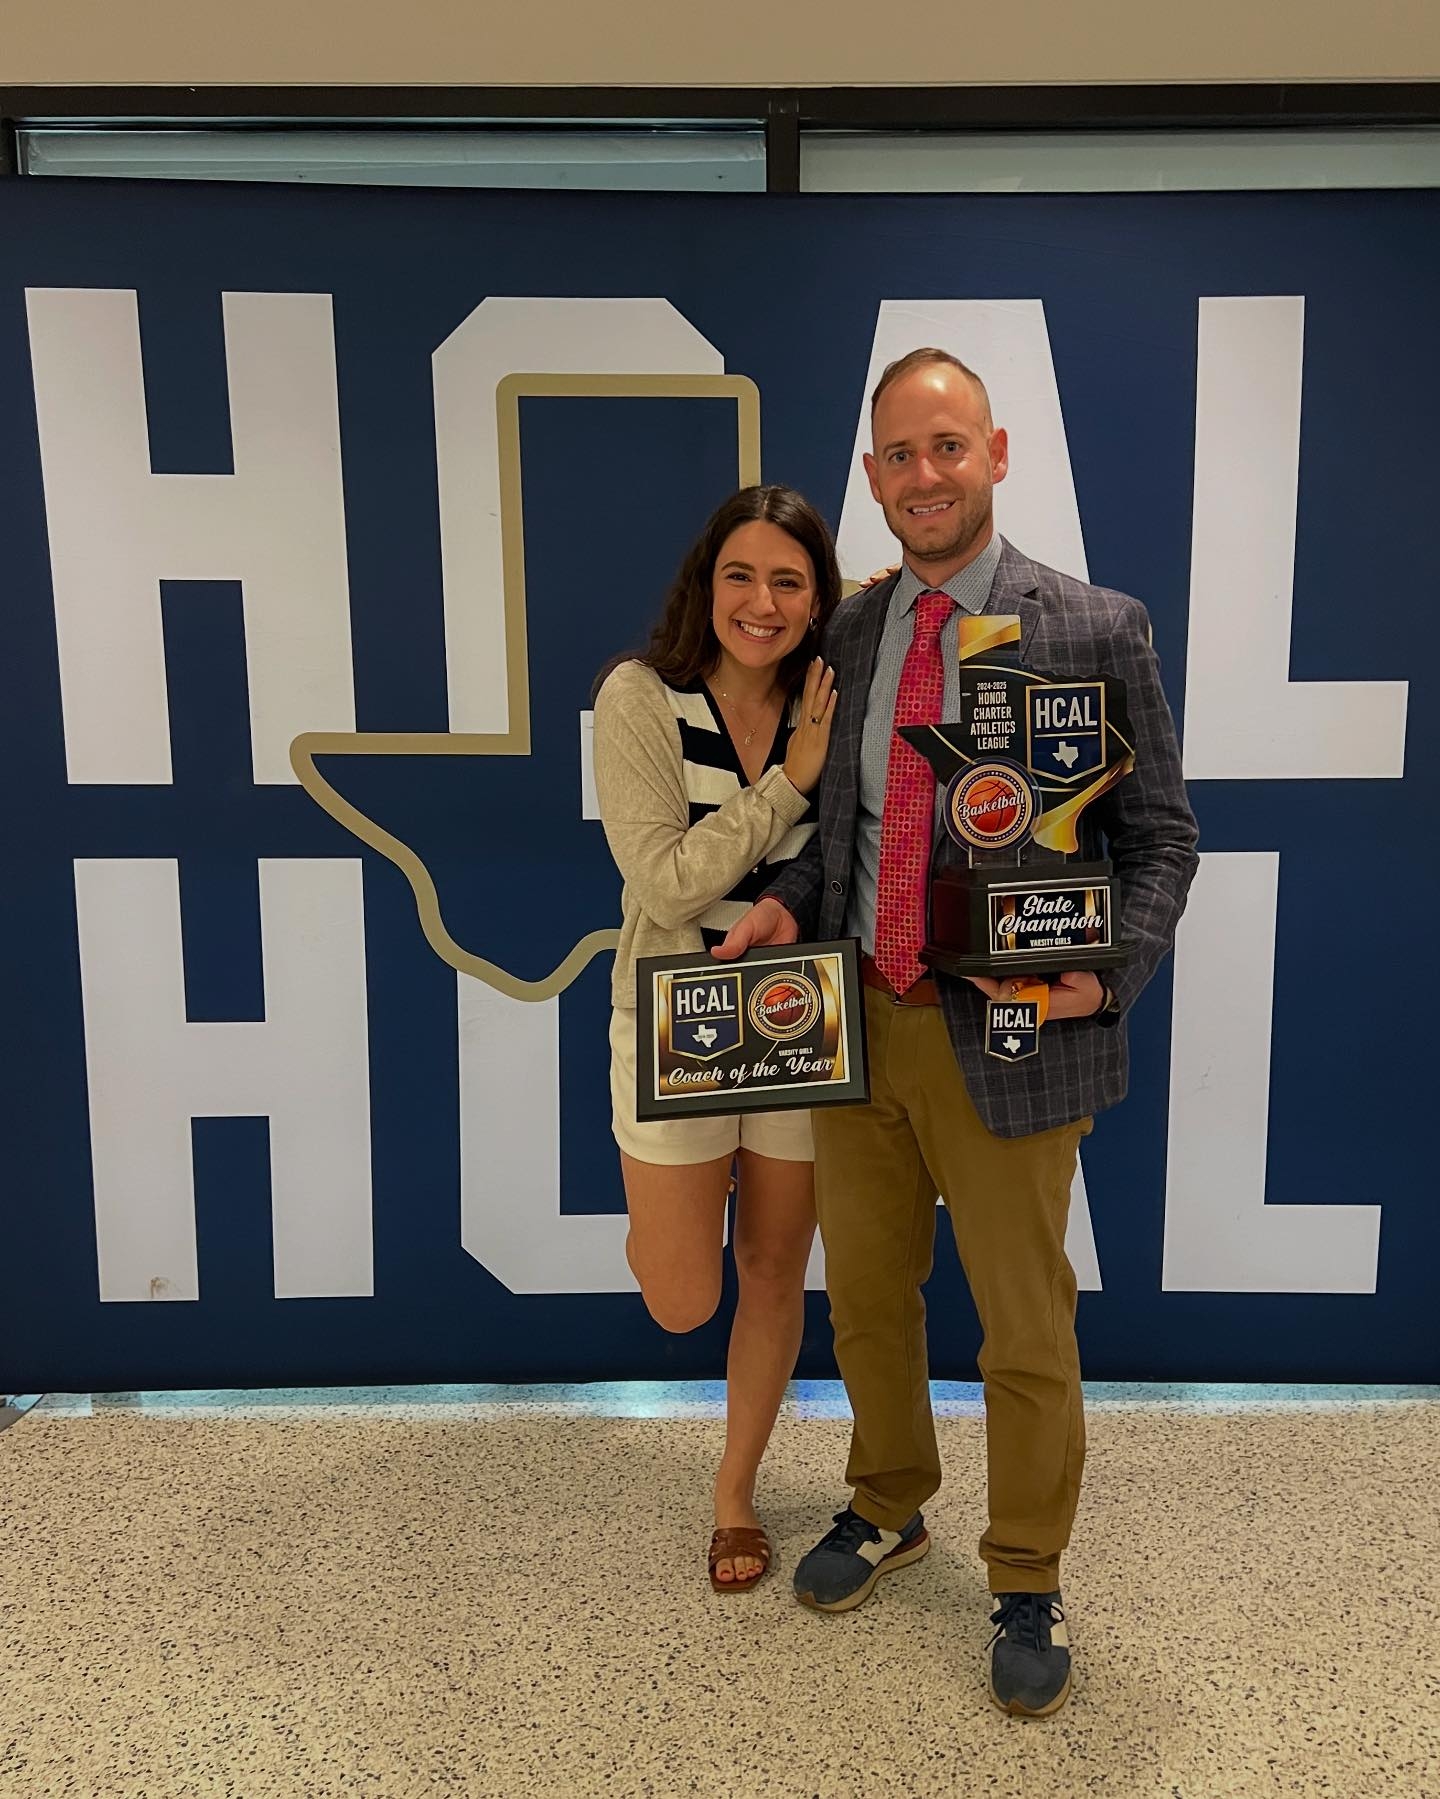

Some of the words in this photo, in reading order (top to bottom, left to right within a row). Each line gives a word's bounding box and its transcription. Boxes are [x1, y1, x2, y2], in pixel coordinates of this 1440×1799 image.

[977, 682, 1007, 690] 2024-2025
[978, 692, 1007, 705] HONOR
[973, 706, 1012, 720] CHARTER
[1035, 696, 1098, 729] HCAL
[970, 721, 1016, 736] ATHLETICS
[977, 736, 1010, 750] LEAGUE
[957, 791, 1025, 820] Basketball
[1022, 895, 1075, 917] State
[997, 912, 1104, 936] Champion
[1030, 938, 1054, 947] VARSITY
[1055, 936, 1072, 945] GIRLS
[676, 985, 736, 1016] HCAL
[754, 993, 812, 1018] Basketball
[992, 1008, 1035, 1028] HCAL
[668, 1066, 725, 1086] Coach
[729, 1064, 752, 1084] of
[752, 1062, 780, 1078] the
[785, 1056, 834, 1075] Year
